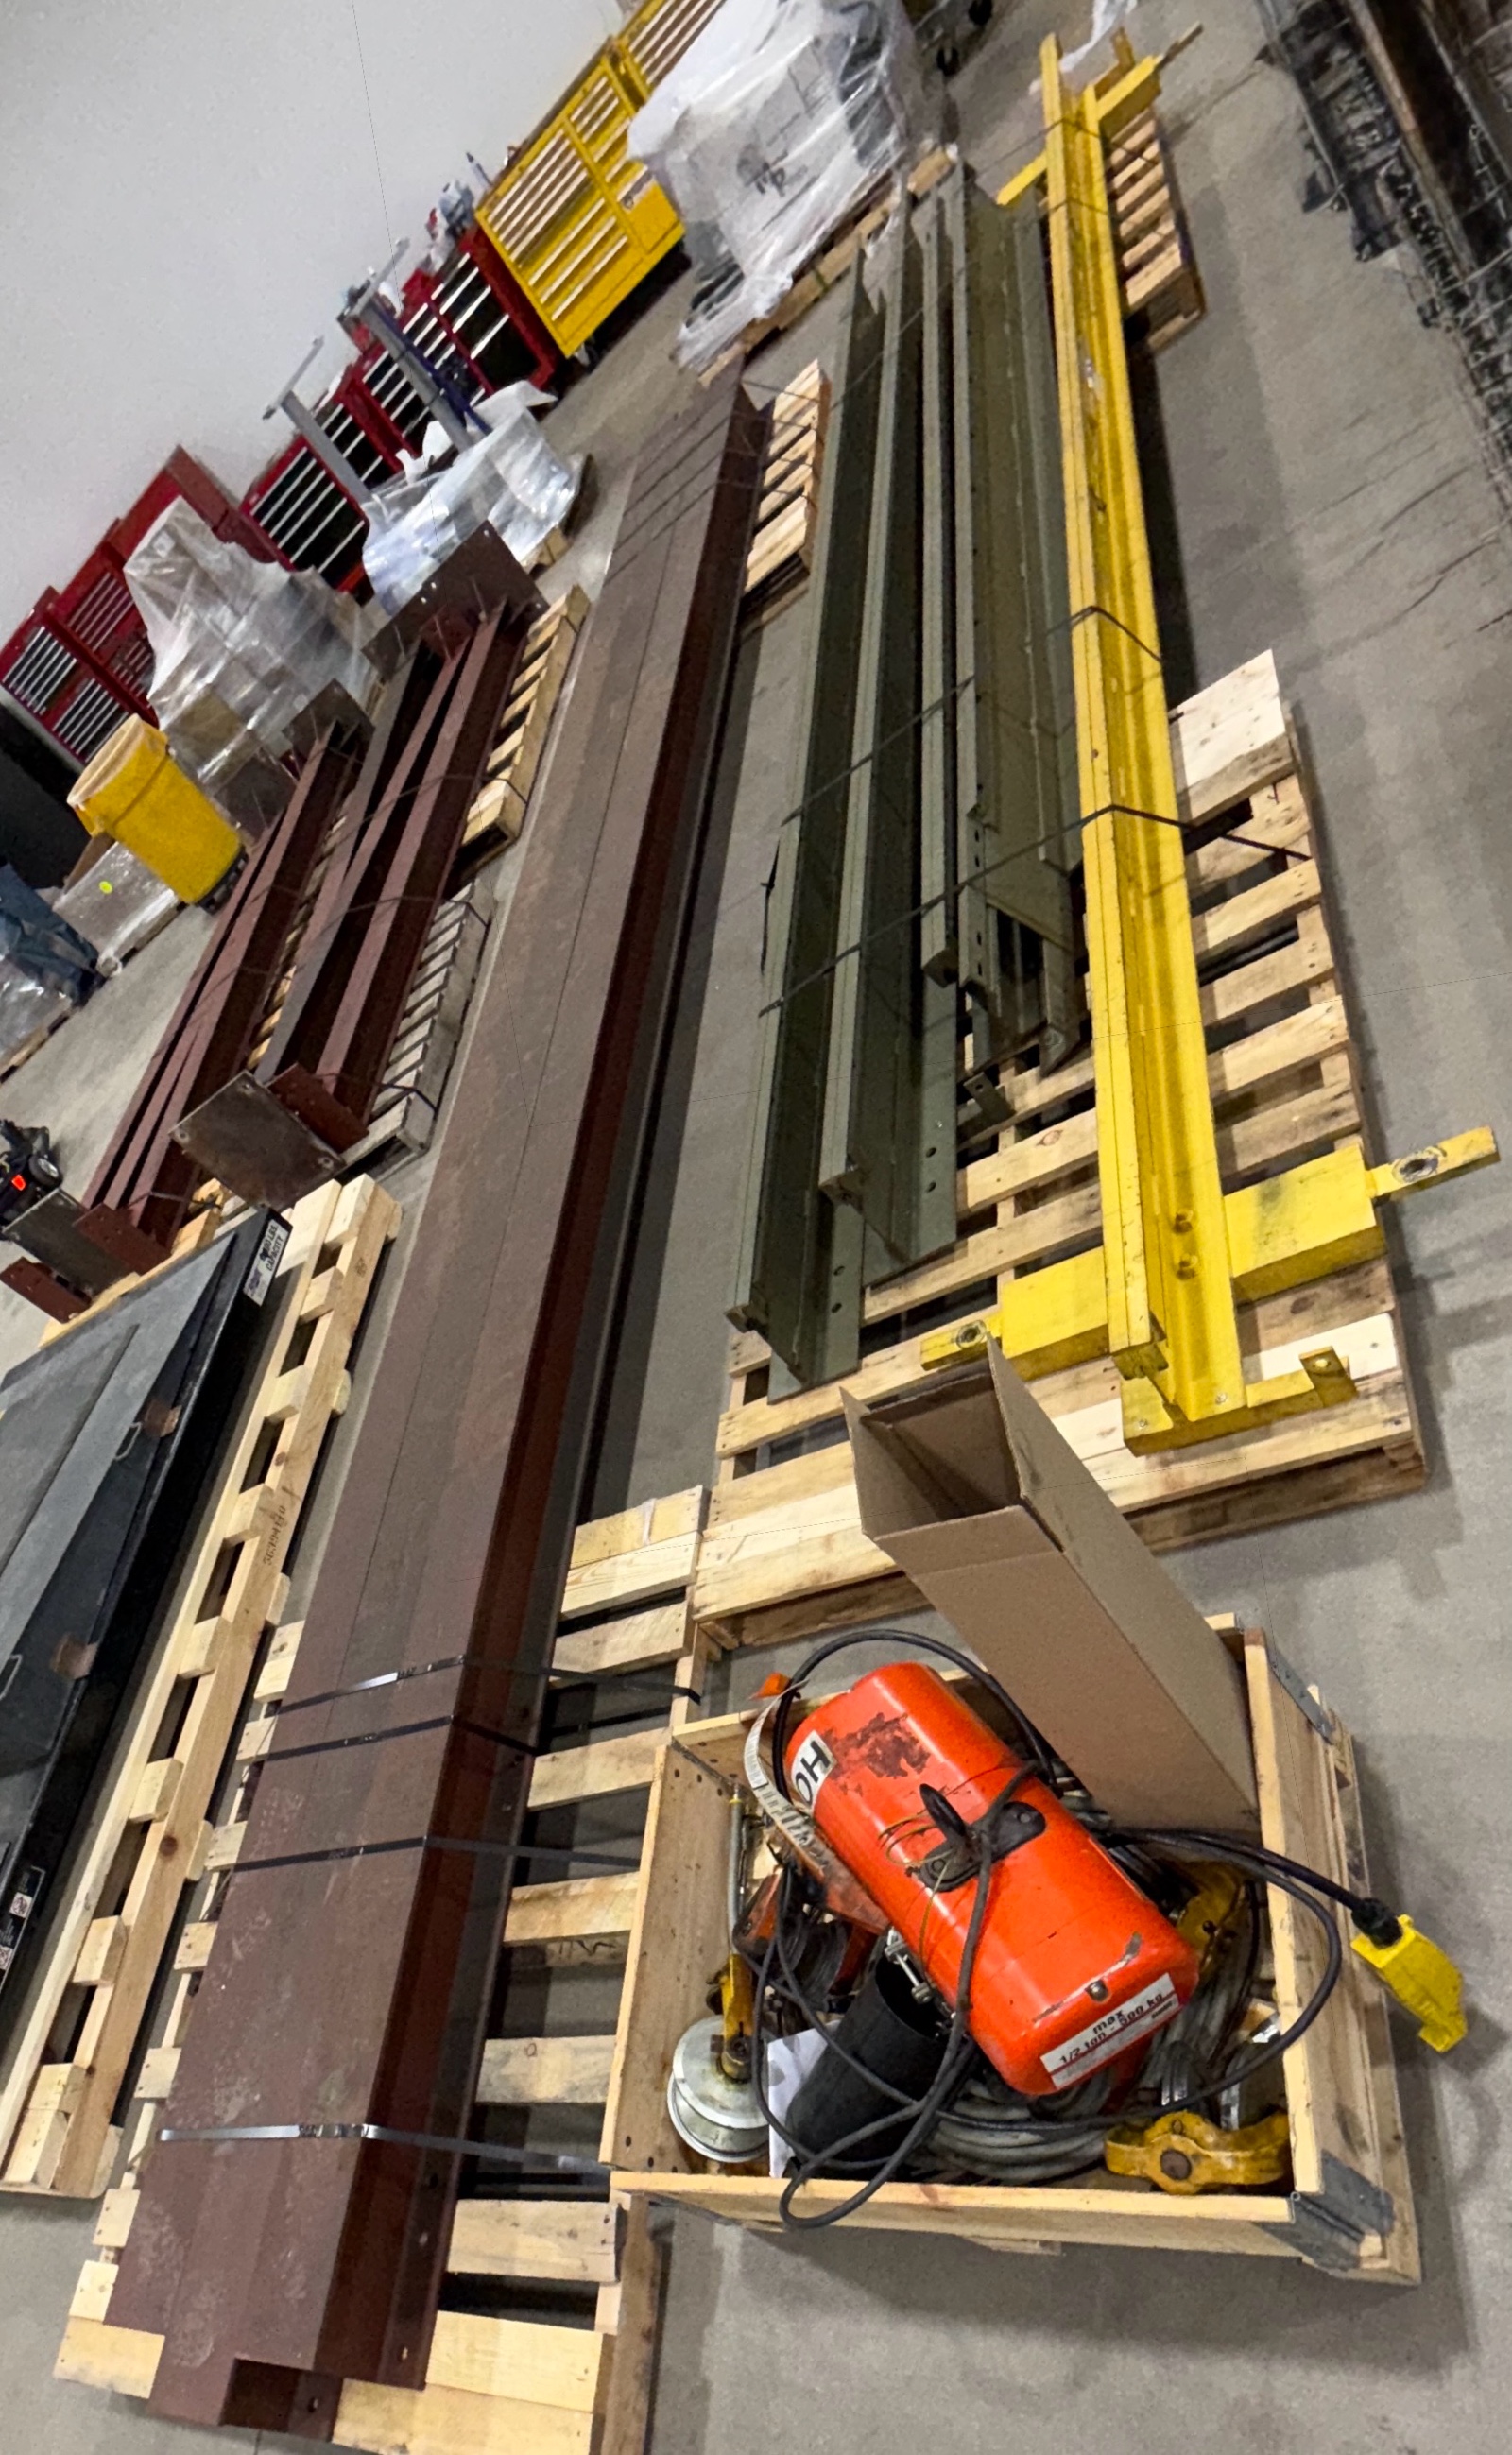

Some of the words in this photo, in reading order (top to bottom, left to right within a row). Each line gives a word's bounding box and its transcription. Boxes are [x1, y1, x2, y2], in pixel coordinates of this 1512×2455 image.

[266, 1235, 284, 1271] CAPACITY
[795, 1740, 831, 1804] HO
[1059, 2047, 1081, 2064] 1/2
[1084, 2032, 1107, 2050] ton
[1146, 1993, 1163, 2008] kg
[1092, 2009, 1125, 2034] max
